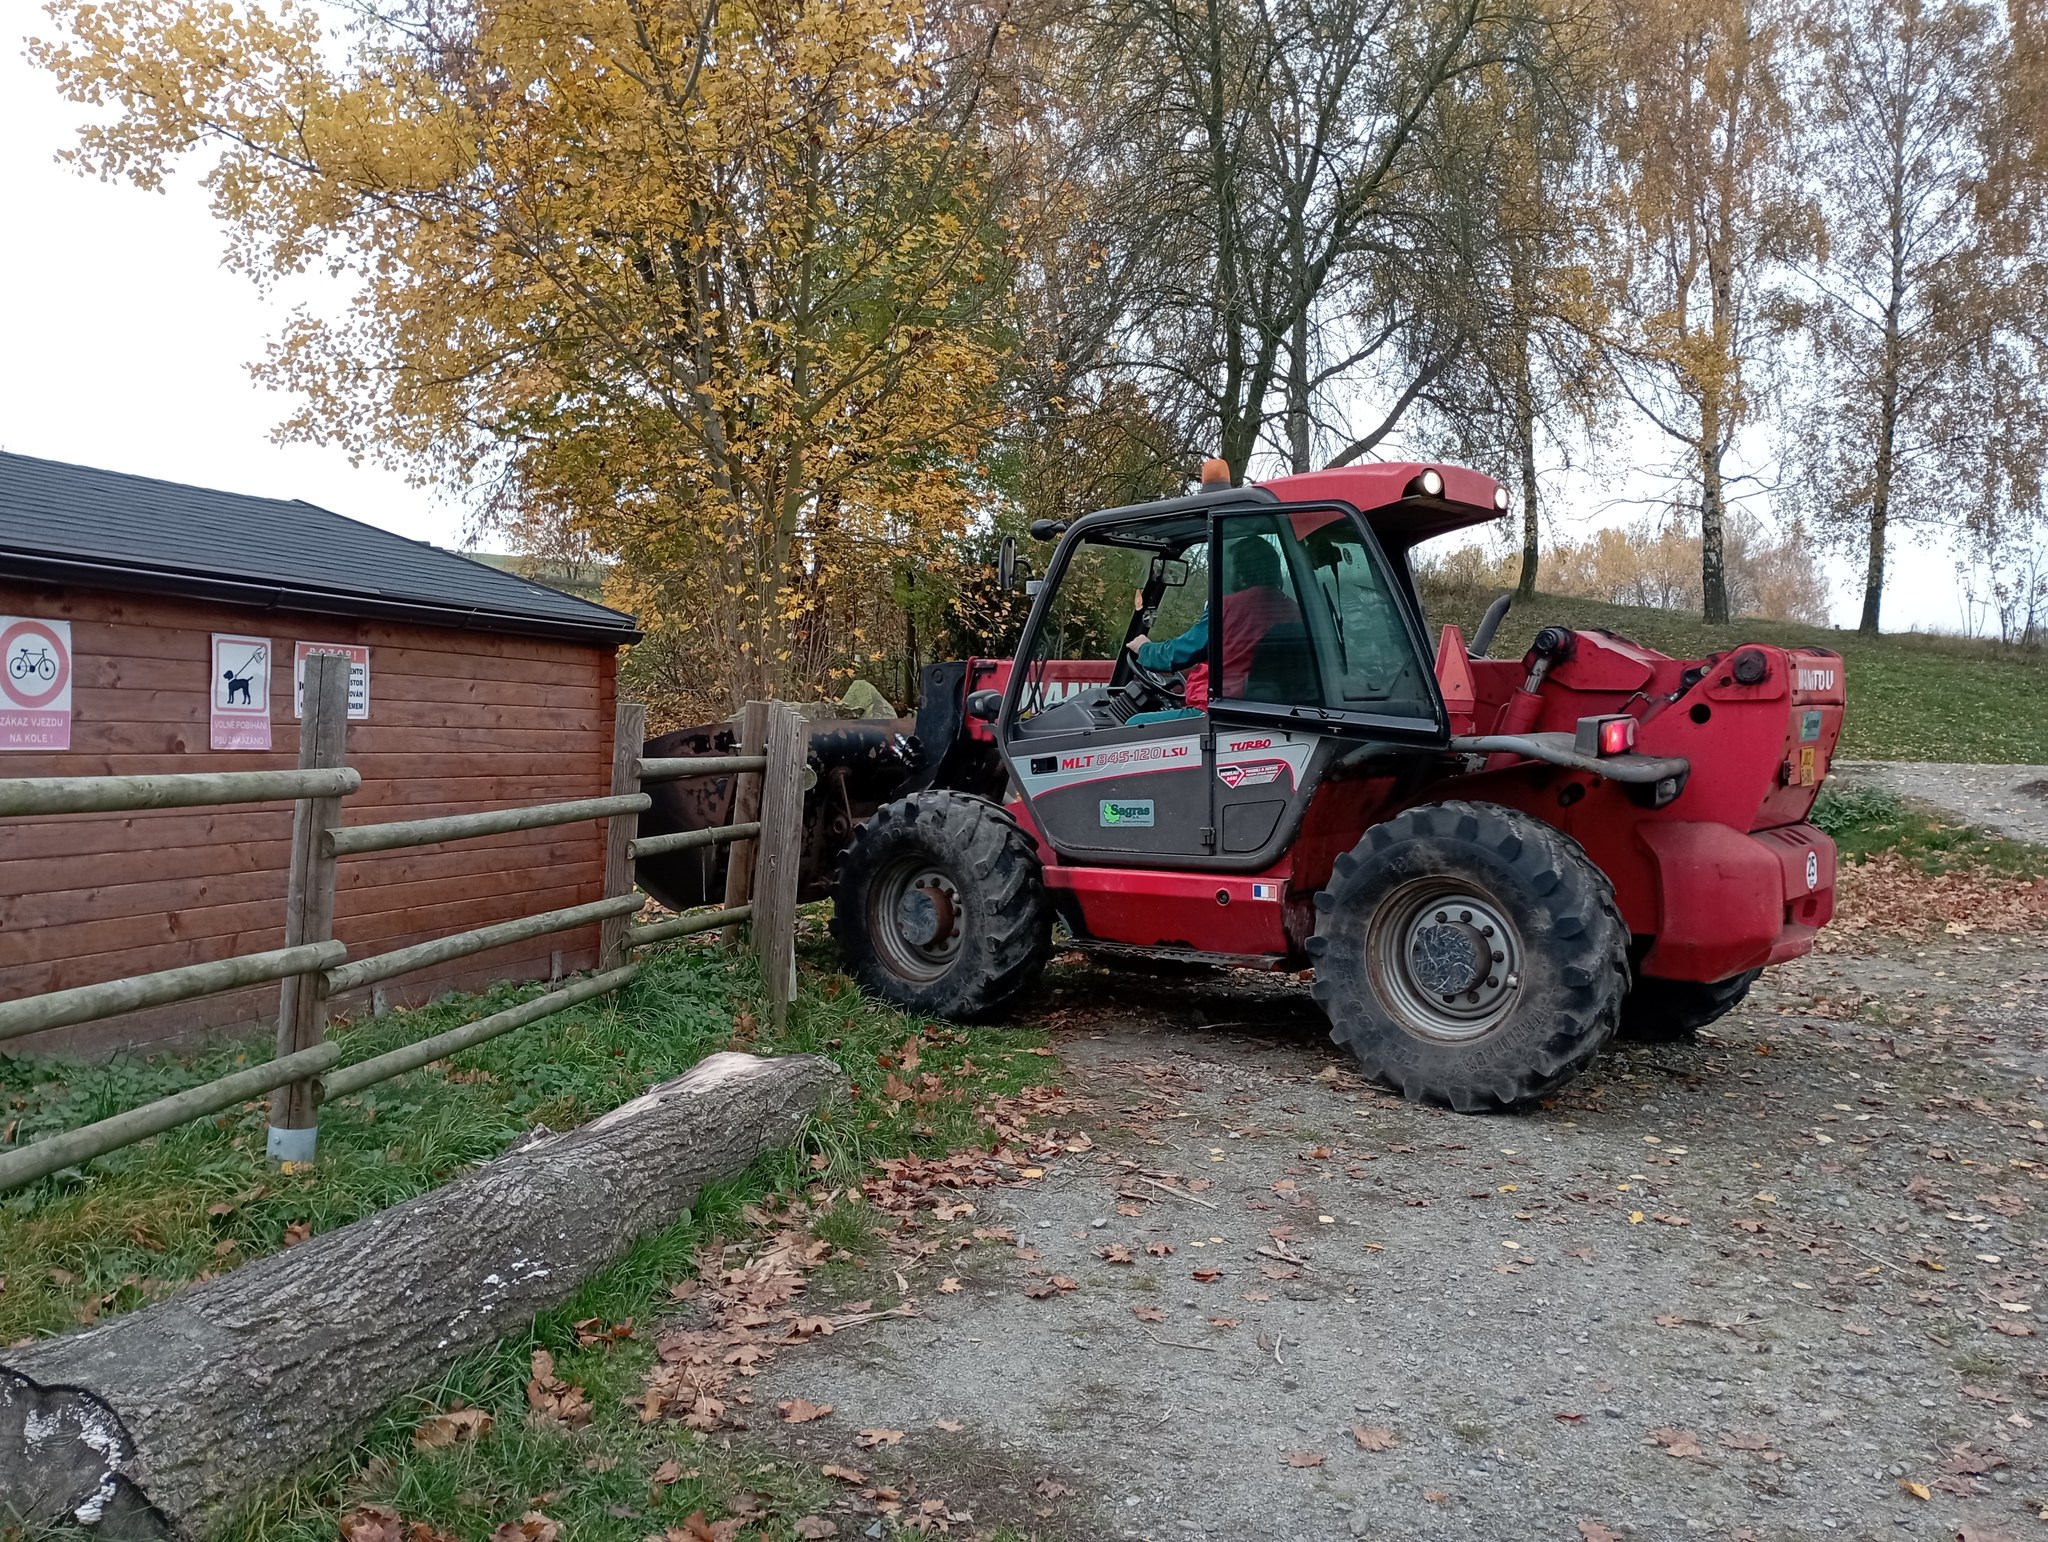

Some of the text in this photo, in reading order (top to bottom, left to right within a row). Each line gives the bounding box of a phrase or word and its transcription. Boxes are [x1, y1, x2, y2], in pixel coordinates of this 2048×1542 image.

[1798, 668, 1834, 691] MANITOU
[0, 714, 63, 727] ZÁKAZ VJEZDU
[213, 718, 236, 729] VOLNÉ
[10, 733, 23, 743] NA
[24, 733, 48, 743] KOLE
[1230, 738, 1272, 752] TURBO
[1061, 746, 1188, 770] MLT 845-120 LSU
[1110, 803, 1150, 818] Sagras
[1807, 855, 1816, 878] 25
